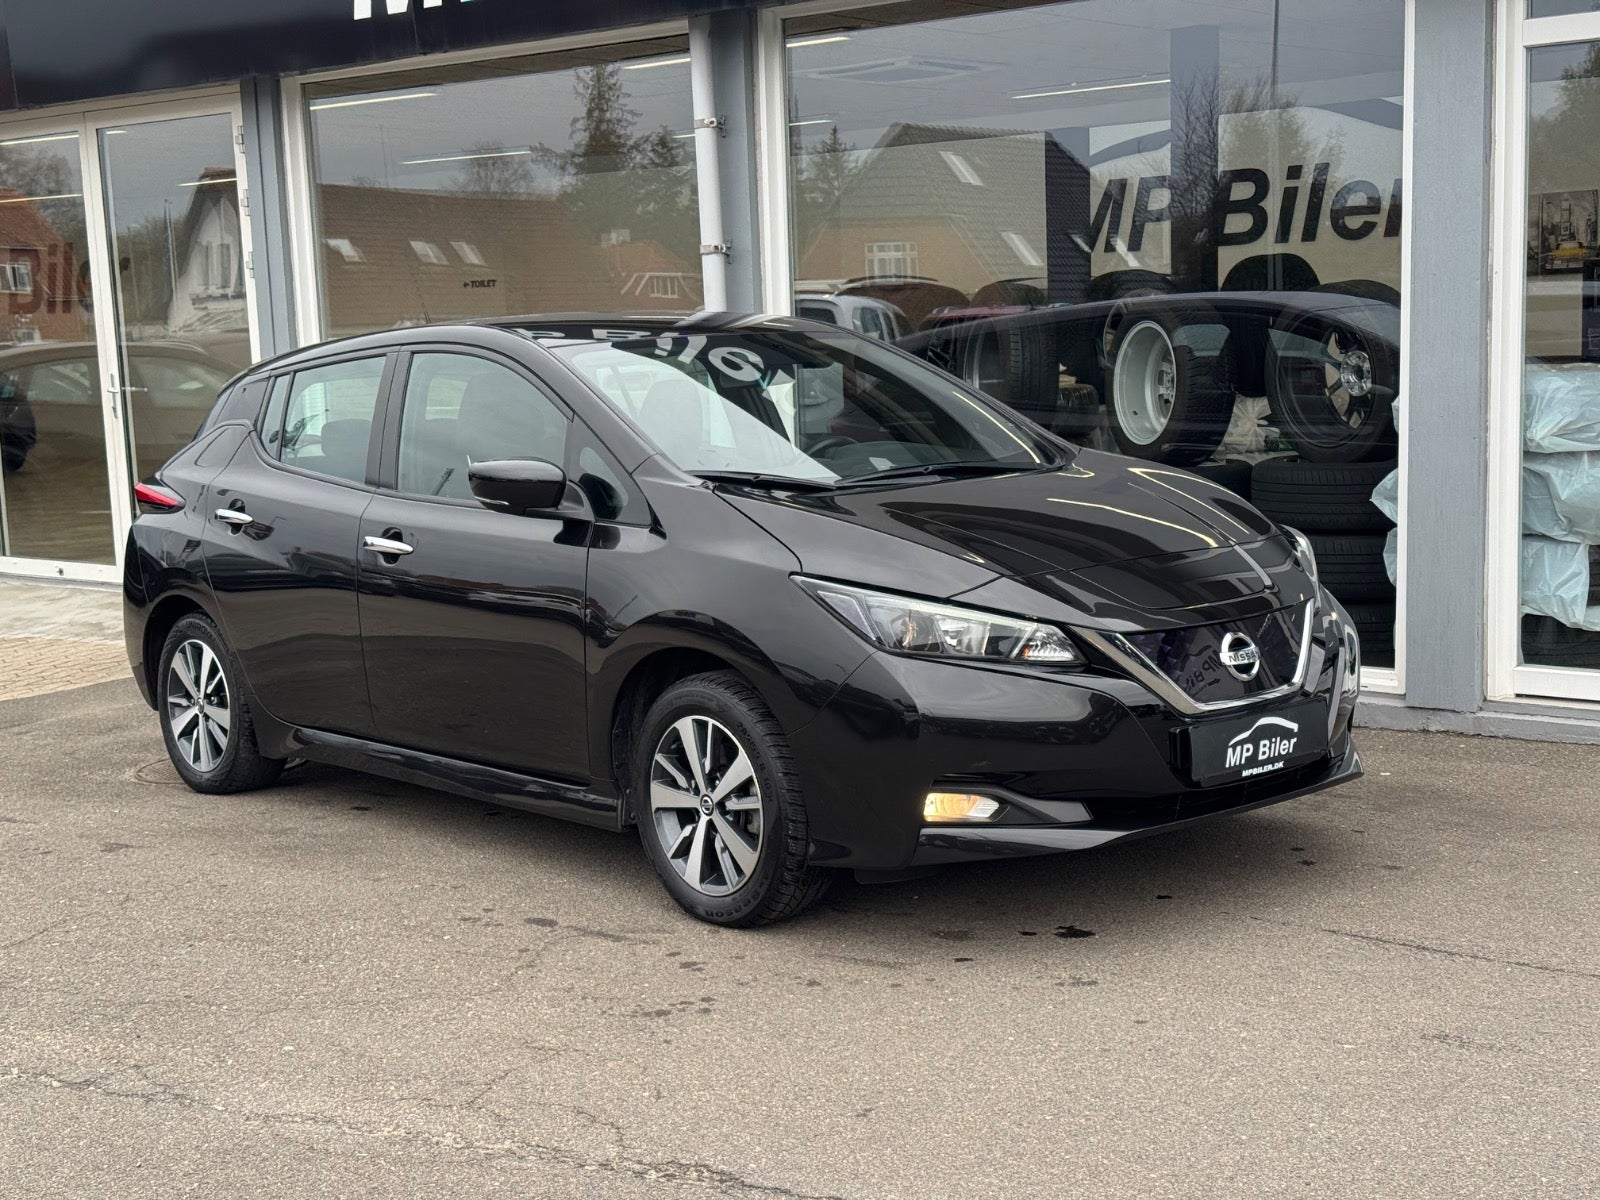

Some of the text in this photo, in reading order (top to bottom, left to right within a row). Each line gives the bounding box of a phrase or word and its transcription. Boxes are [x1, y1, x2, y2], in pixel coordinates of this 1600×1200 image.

[469, 279, 497, 289] TOILET
[1225, 736, 1298, 769] MP Biler
[1242, 760, 1285, 778] MPBILER.DK
